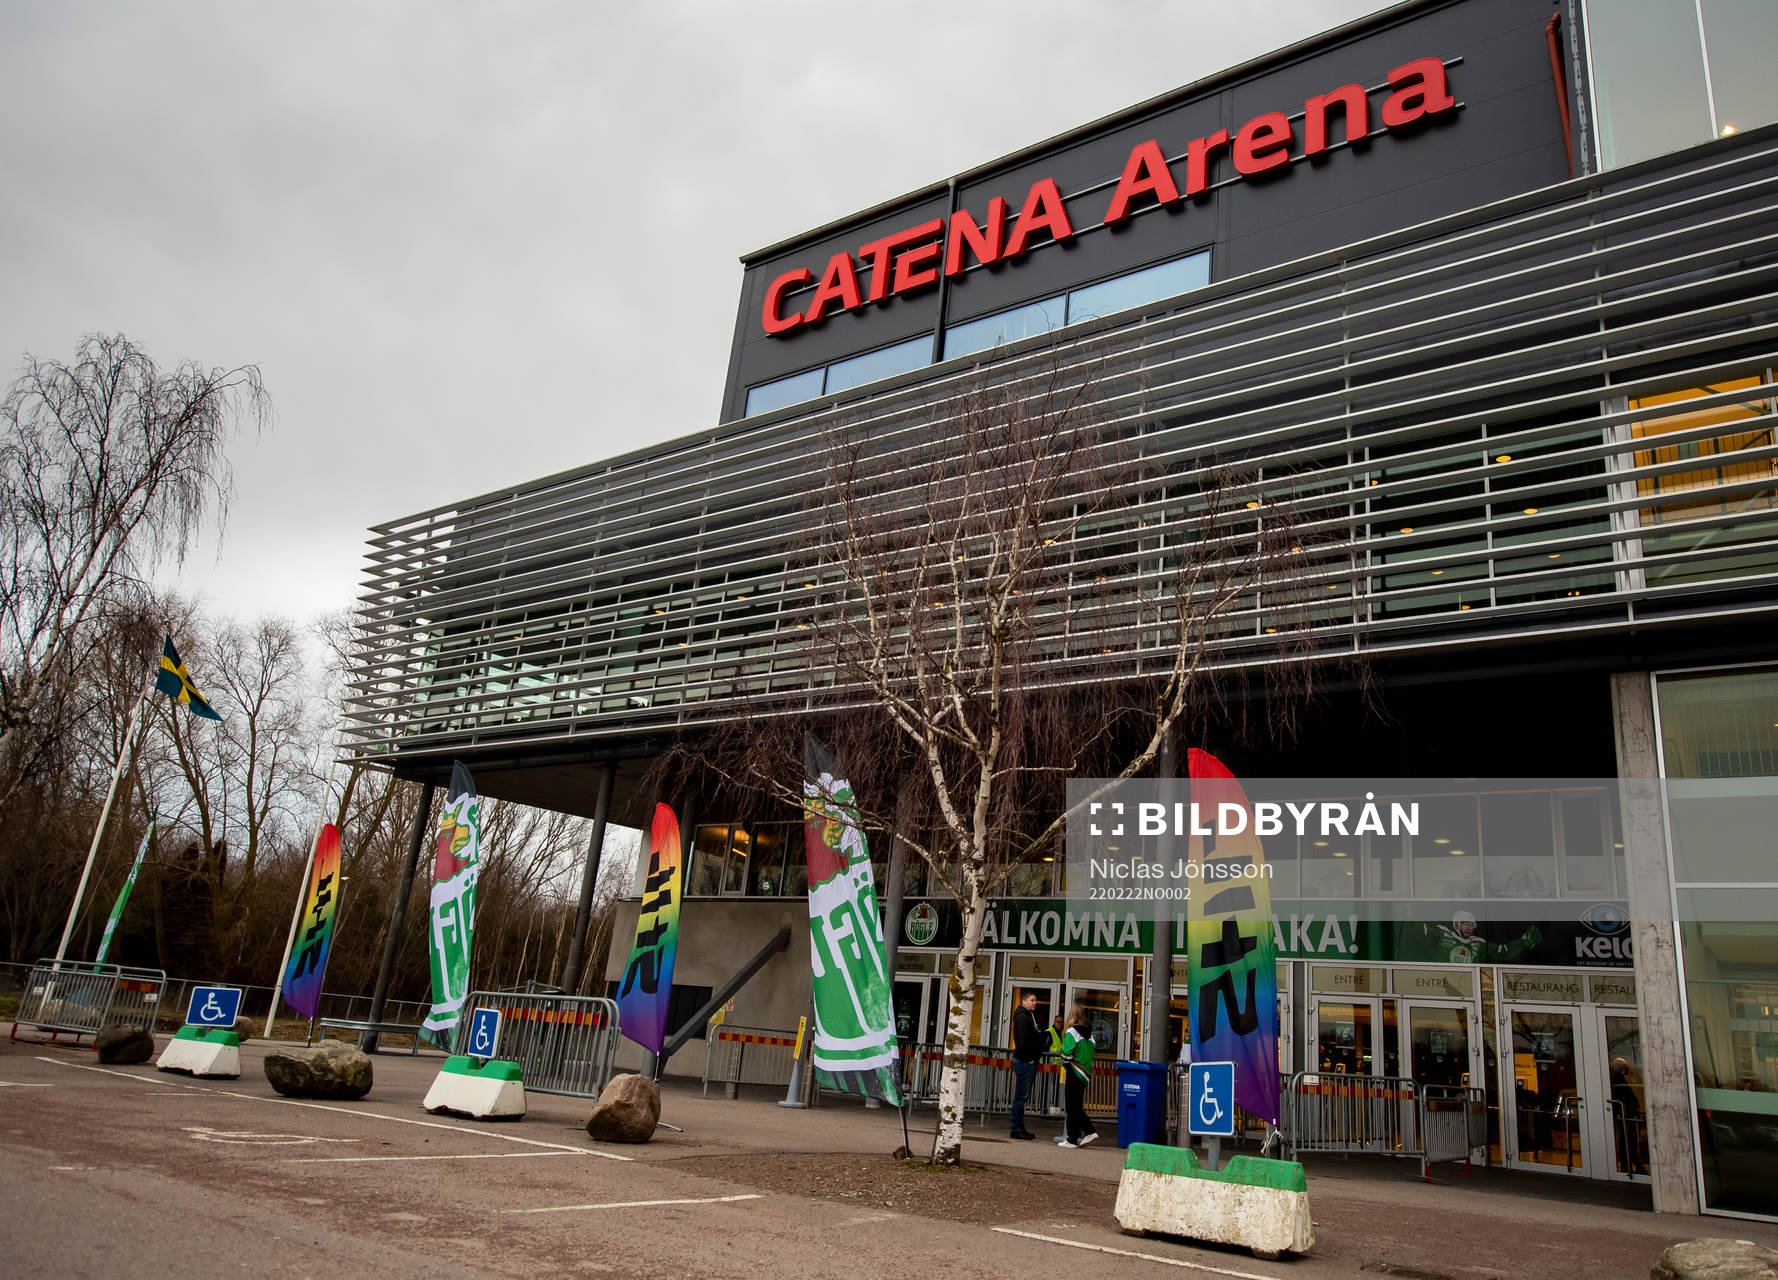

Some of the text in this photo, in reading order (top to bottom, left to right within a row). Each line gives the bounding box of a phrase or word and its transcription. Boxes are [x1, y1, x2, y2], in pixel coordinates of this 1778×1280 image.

[761, 56, 1457, 336] CATENA Arena
[979, 901, 1140, 949] ÄLKOMNA
[1506, 980, 1580, 994] RESTAURANG
[1593, 983, 1636, 996] RESTAU
